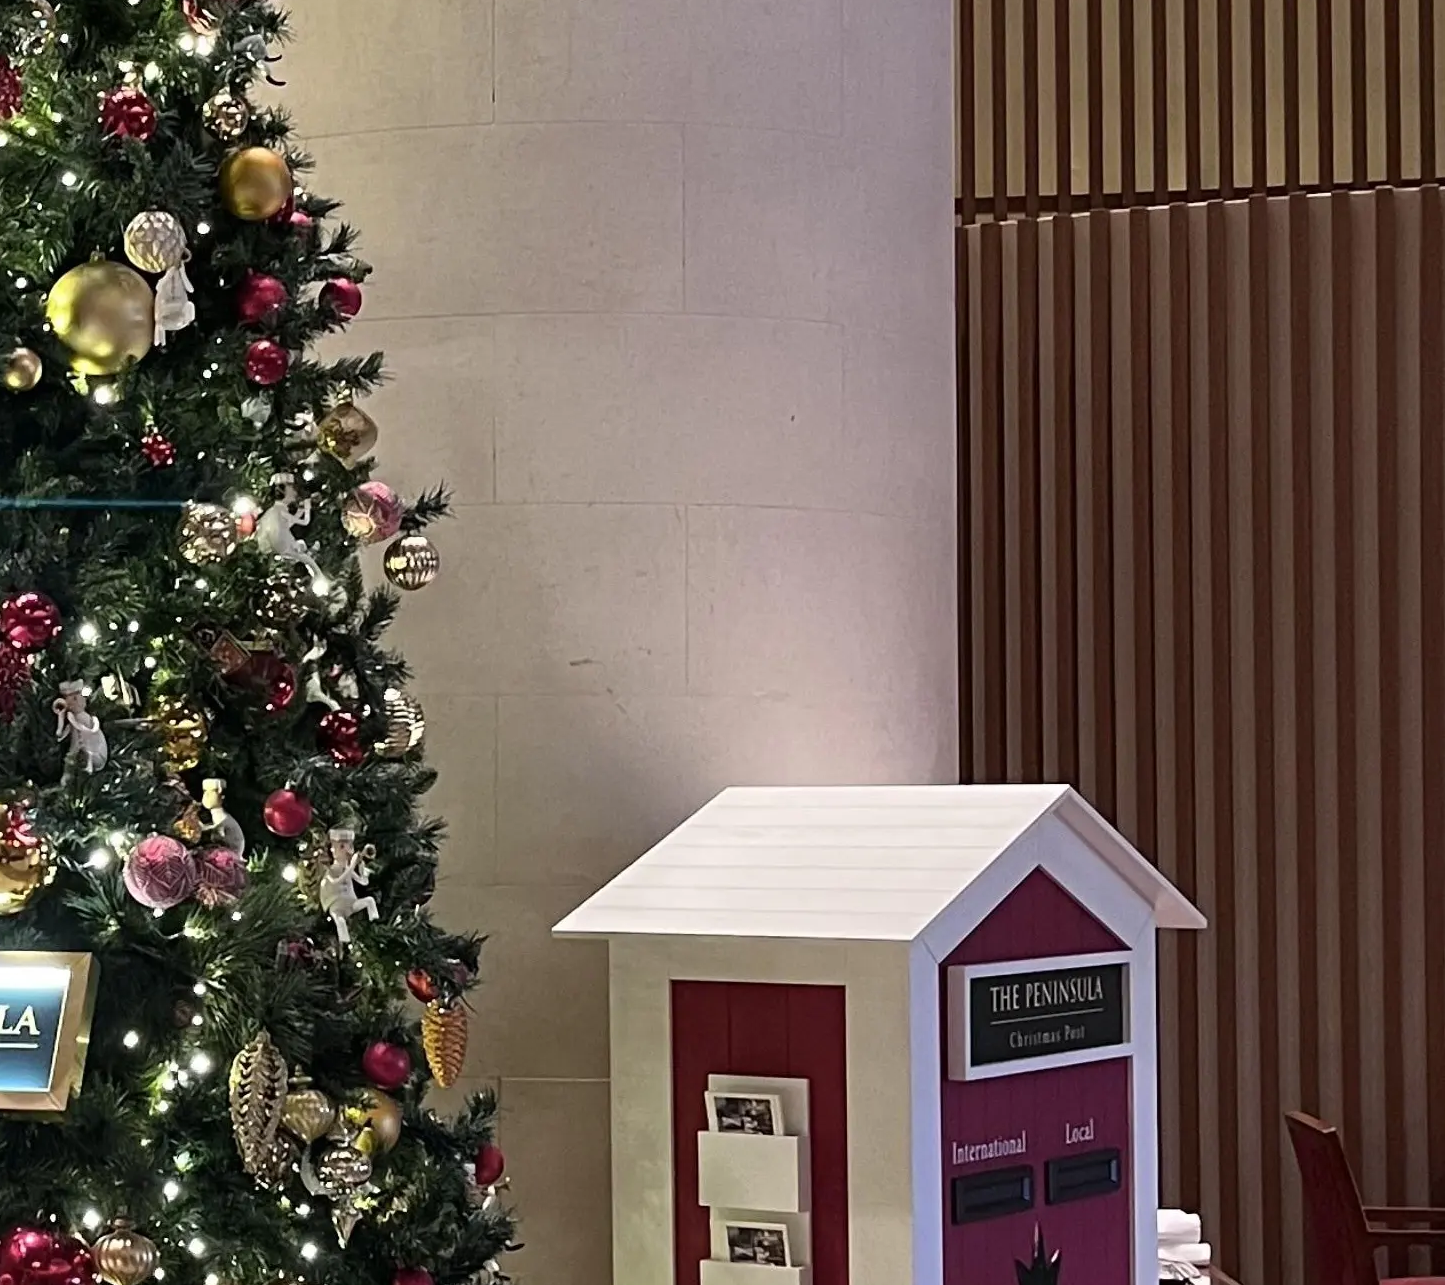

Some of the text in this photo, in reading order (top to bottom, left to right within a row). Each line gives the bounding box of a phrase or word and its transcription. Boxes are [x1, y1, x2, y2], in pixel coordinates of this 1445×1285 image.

[989, 975, 1104, 1013] THE PENINSULA
[1009, 1024, 1086, 1049] Christmas Post
[1065, 1117, 1095, 1145] Local
[952, 1130, 1027, 1165] International
